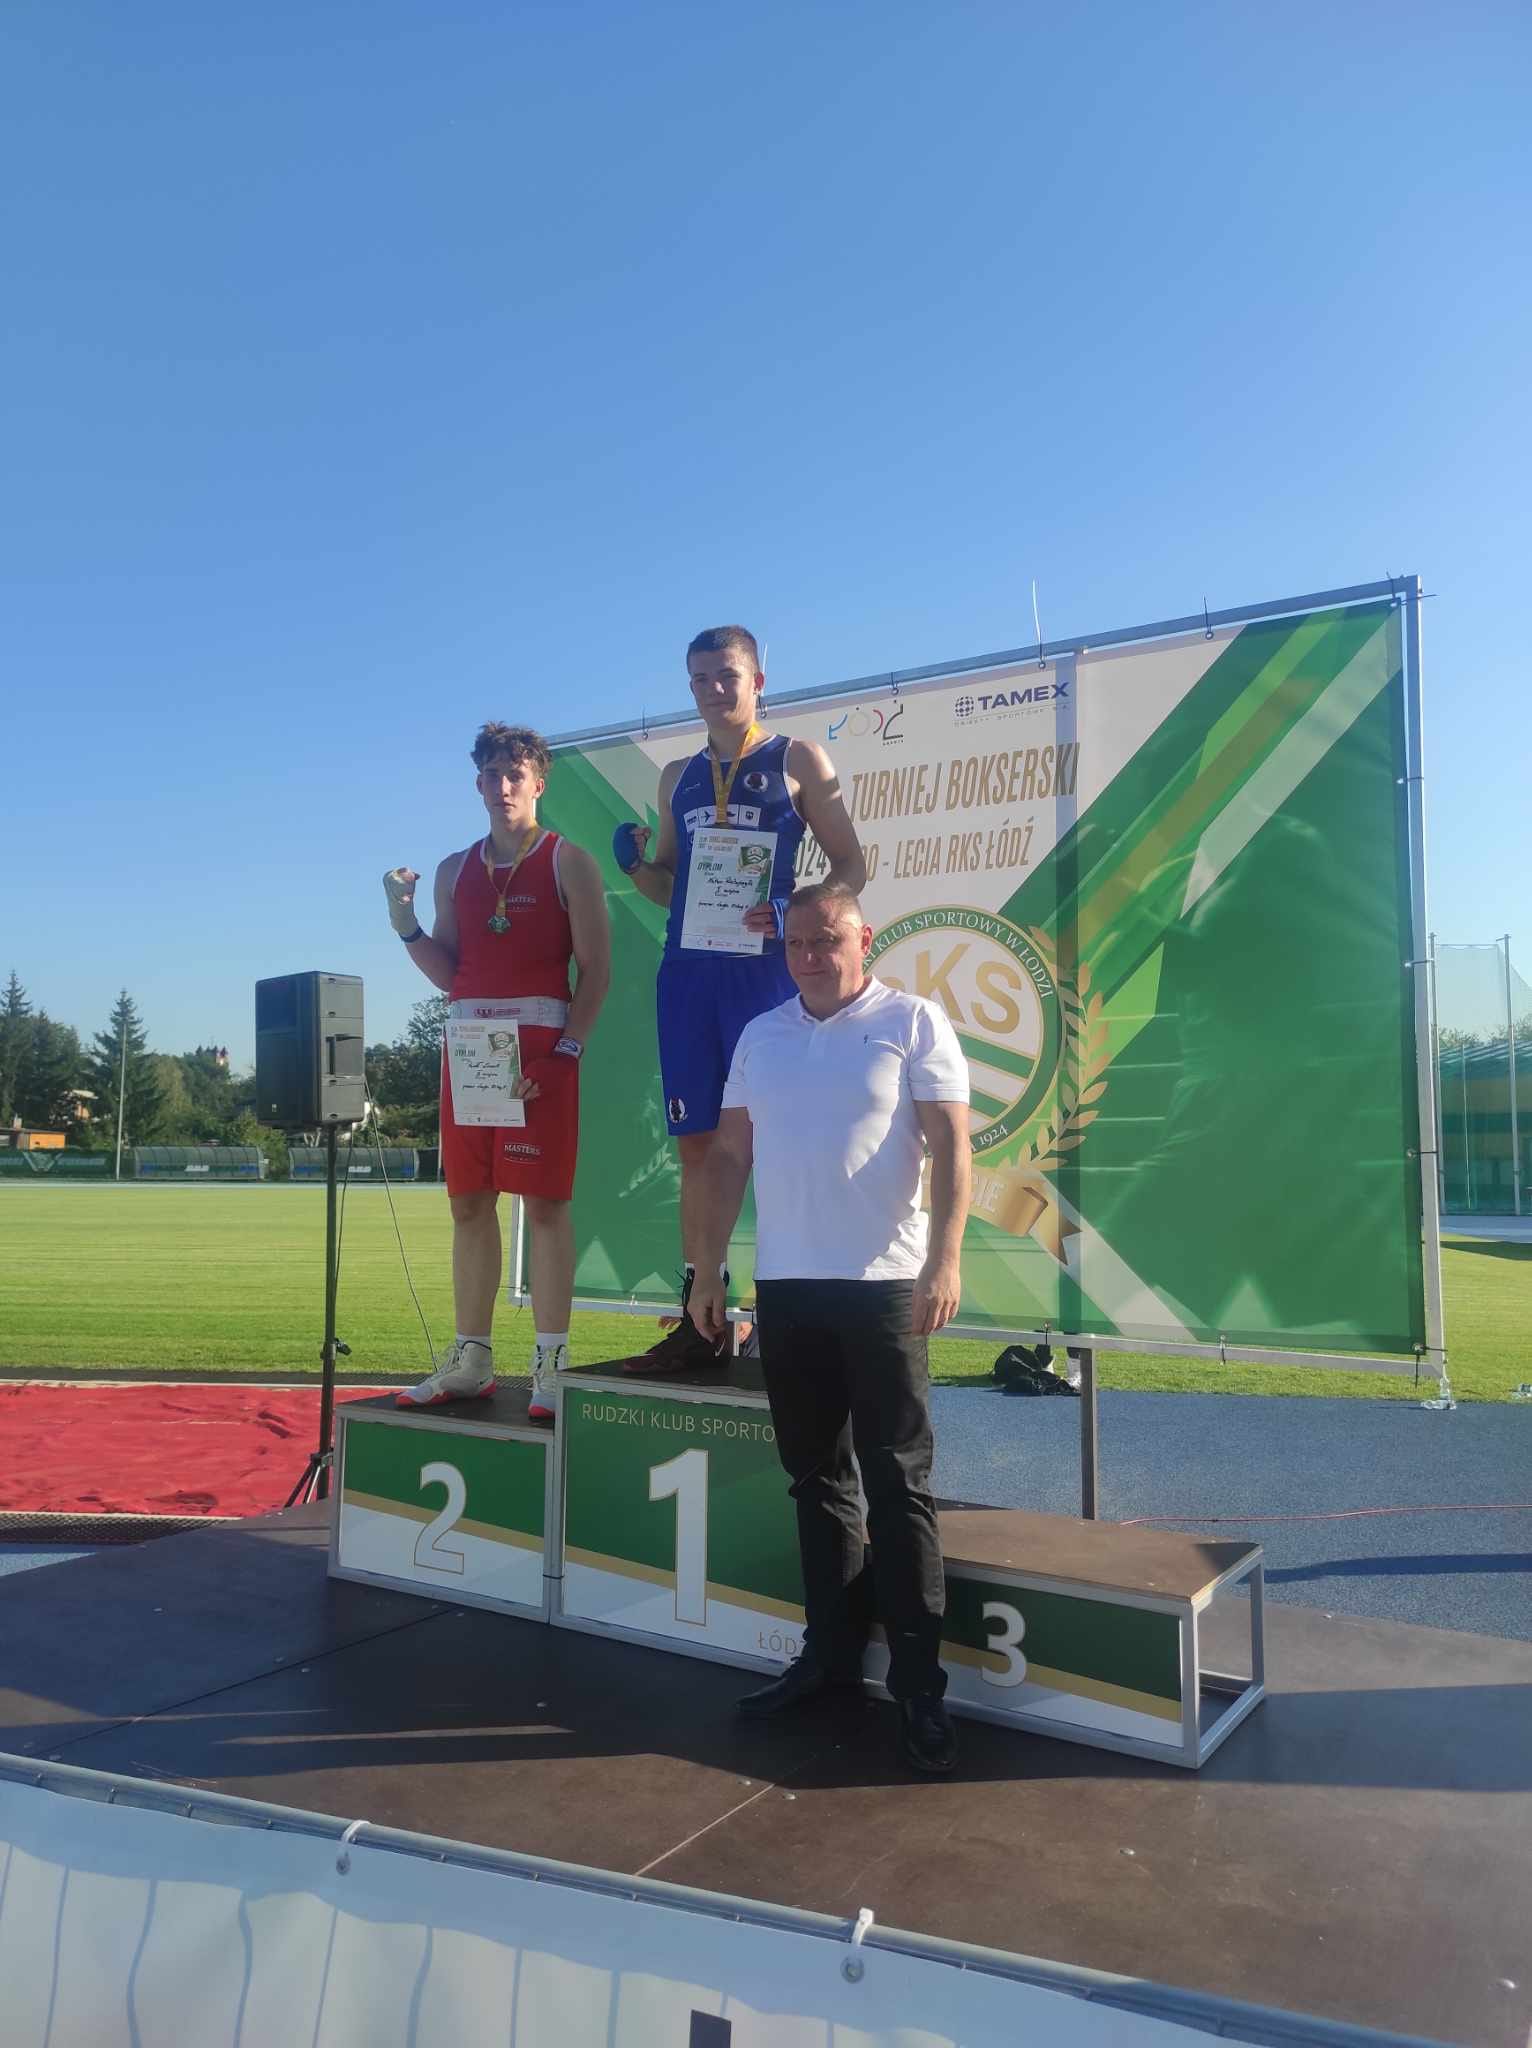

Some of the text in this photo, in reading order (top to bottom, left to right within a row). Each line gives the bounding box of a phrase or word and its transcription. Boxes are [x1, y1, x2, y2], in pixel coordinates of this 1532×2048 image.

[977, 682, 1070, 711] TAMEX
[849, 742, 1081, 822] TURNIEJ BOKSERSKI
[894, 836, 942, 879] LECIA
[945, 831, 983, 873] RKS
[985, 816, 1034, 869] ŁÓDŹ
[875, 921, 912, 951] KLUB
[915, 911, 1006, 938] SPORTOWY
[1006, 932, 1023, 950] W
[879, 943, 1023, 1035] KS
[979, 1124, 1008, 1146] 1924
[582, 1403, 776, 1442] RUDZKI KLUB SPORTO
[413, 1461, 467, 1575] 2
[649, 1448, 709, 1626] 1
[981, 1601, 1027, 1688] 3
